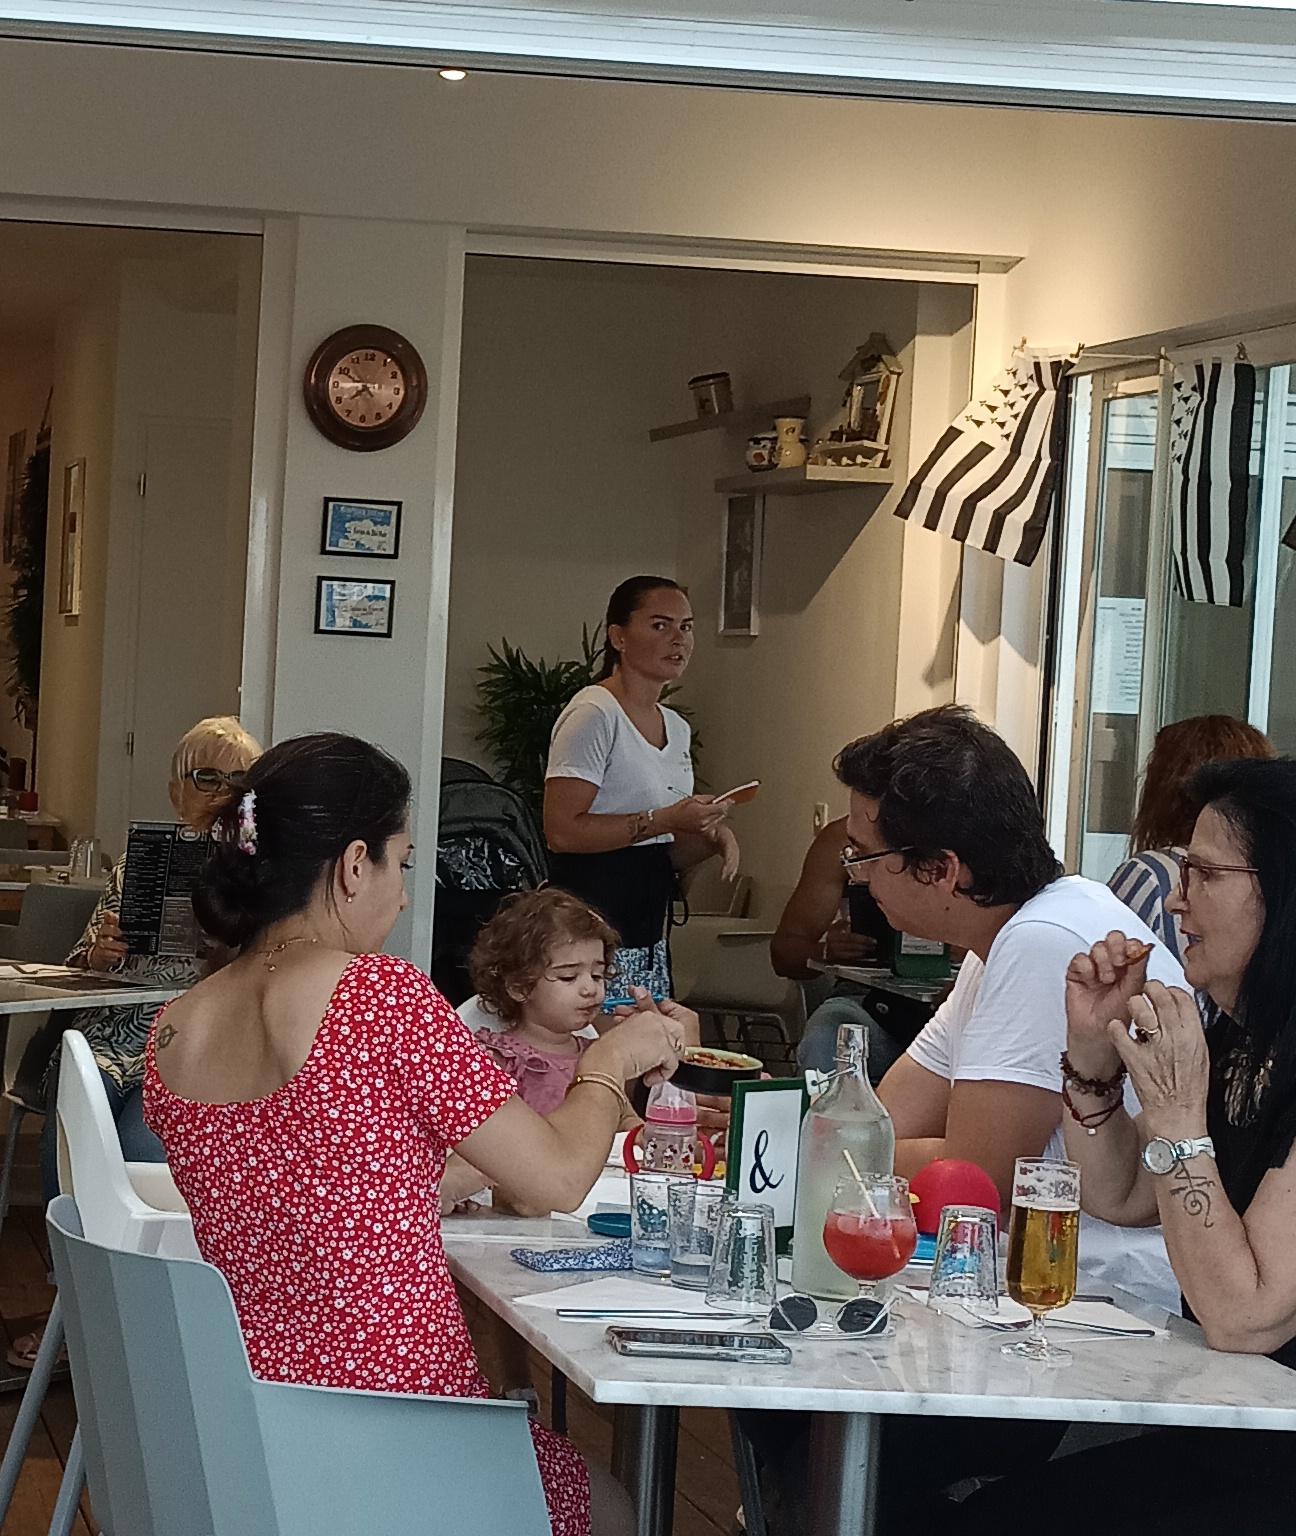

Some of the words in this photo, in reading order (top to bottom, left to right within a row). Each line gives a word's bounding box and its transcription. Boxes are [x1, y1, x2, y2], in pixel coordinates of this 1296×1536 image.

[364, 352, 376, 361] 12
[390, 371, 397, 379] 2
[749, 1129, 785, 1194] &
